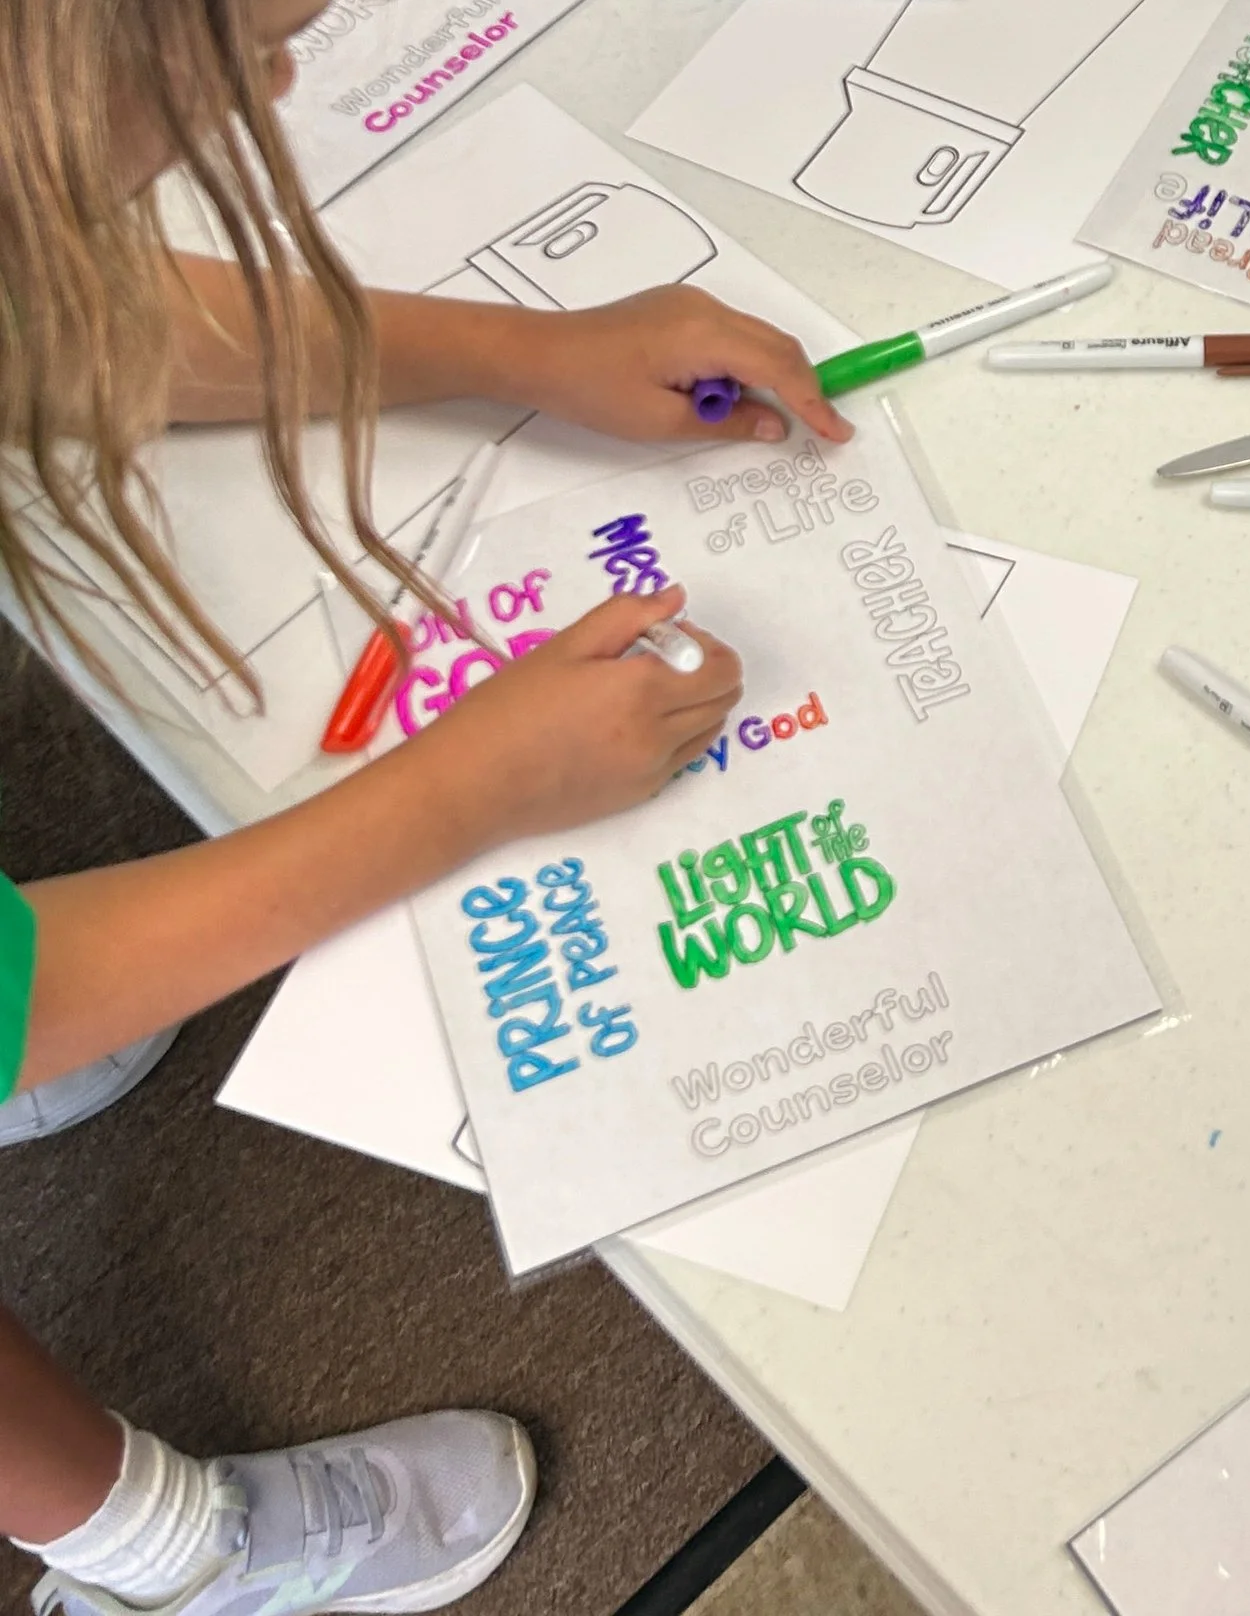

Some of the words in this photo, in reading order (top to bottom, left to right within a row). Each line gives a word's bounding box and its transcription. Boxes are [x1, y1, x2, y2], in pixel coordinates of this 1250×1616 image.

[363, 10, 519, 134] Counselor
[686, 438, 828, 513] Bread
[706, 511, 748, 554] of
[754, 472, 880, 544] Life
[405, 597, 473, 653] ON
[738, 690, 829, 751] God
[657, 856, 898, 990] WORLD
[670, 970, 950, 1111] Wonderful
[690, 1029, 954, 1158] Counselor
